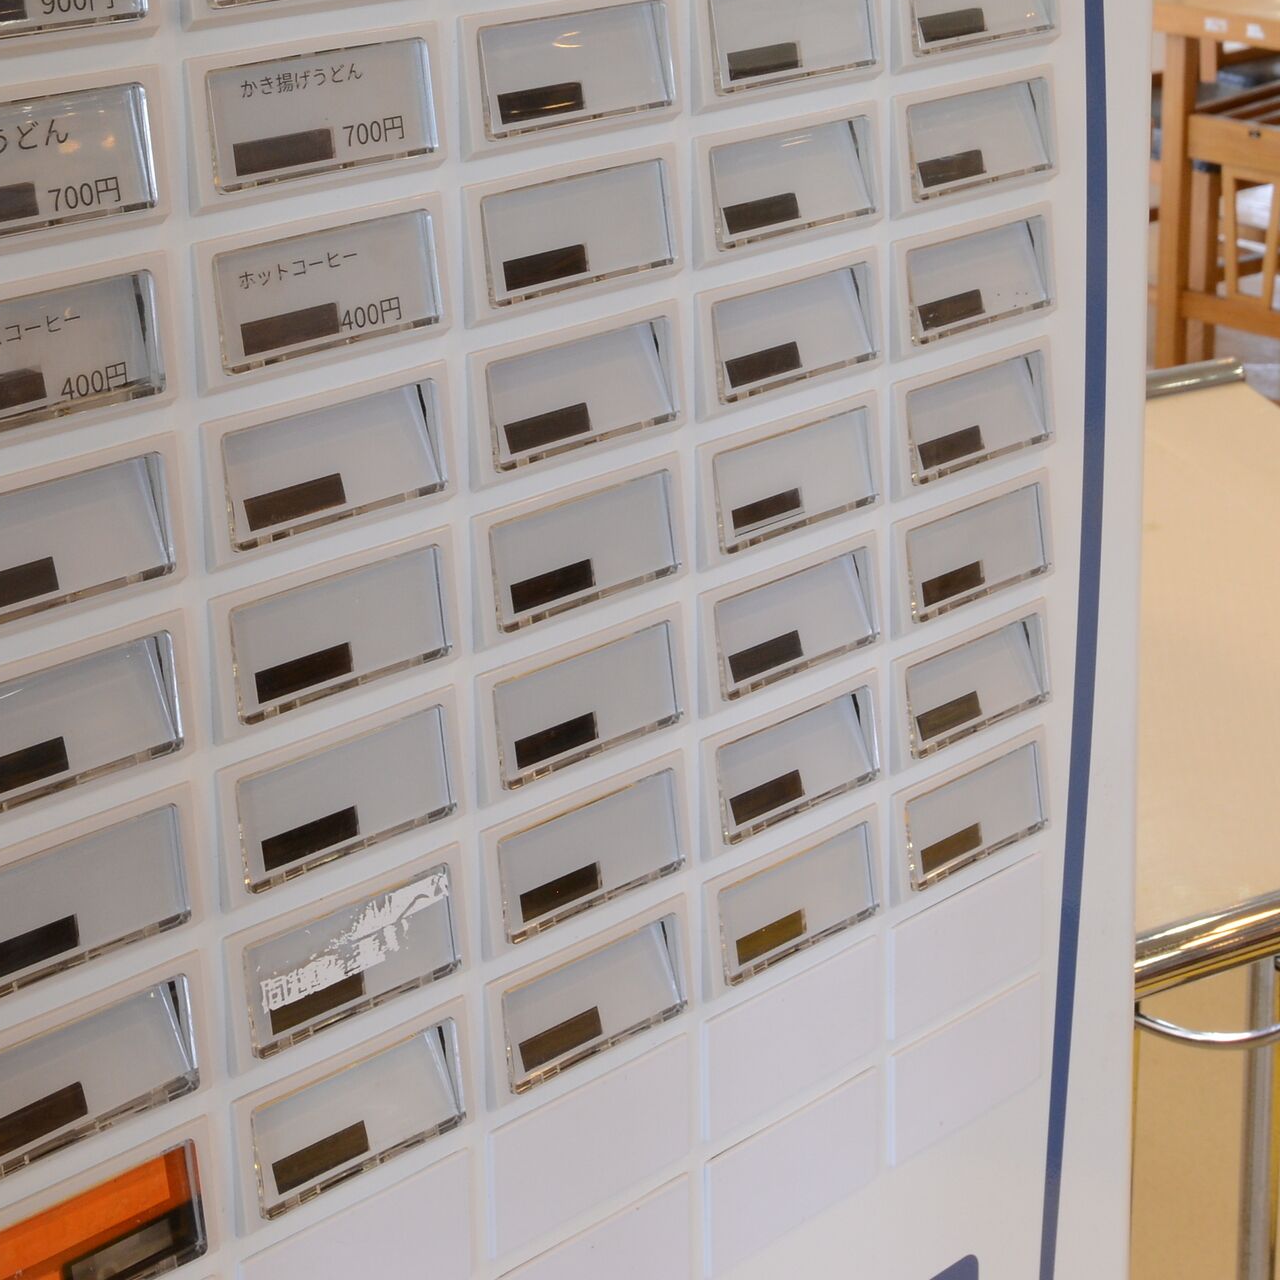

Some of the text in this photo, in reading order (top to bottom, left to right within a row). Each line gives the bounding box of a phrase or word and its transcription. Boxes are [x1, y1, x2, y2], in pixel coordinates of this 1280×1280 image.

[239, 62, 364, 100] かき揚げうどん
[342, 115, 406, 148] 700円
[47, 176, 122, 213] 700円
[238, 251, 360, 291] ホットコーヒー
[341, 296, 404, 332] 400円
[60, 360, 130, 402] 400円
